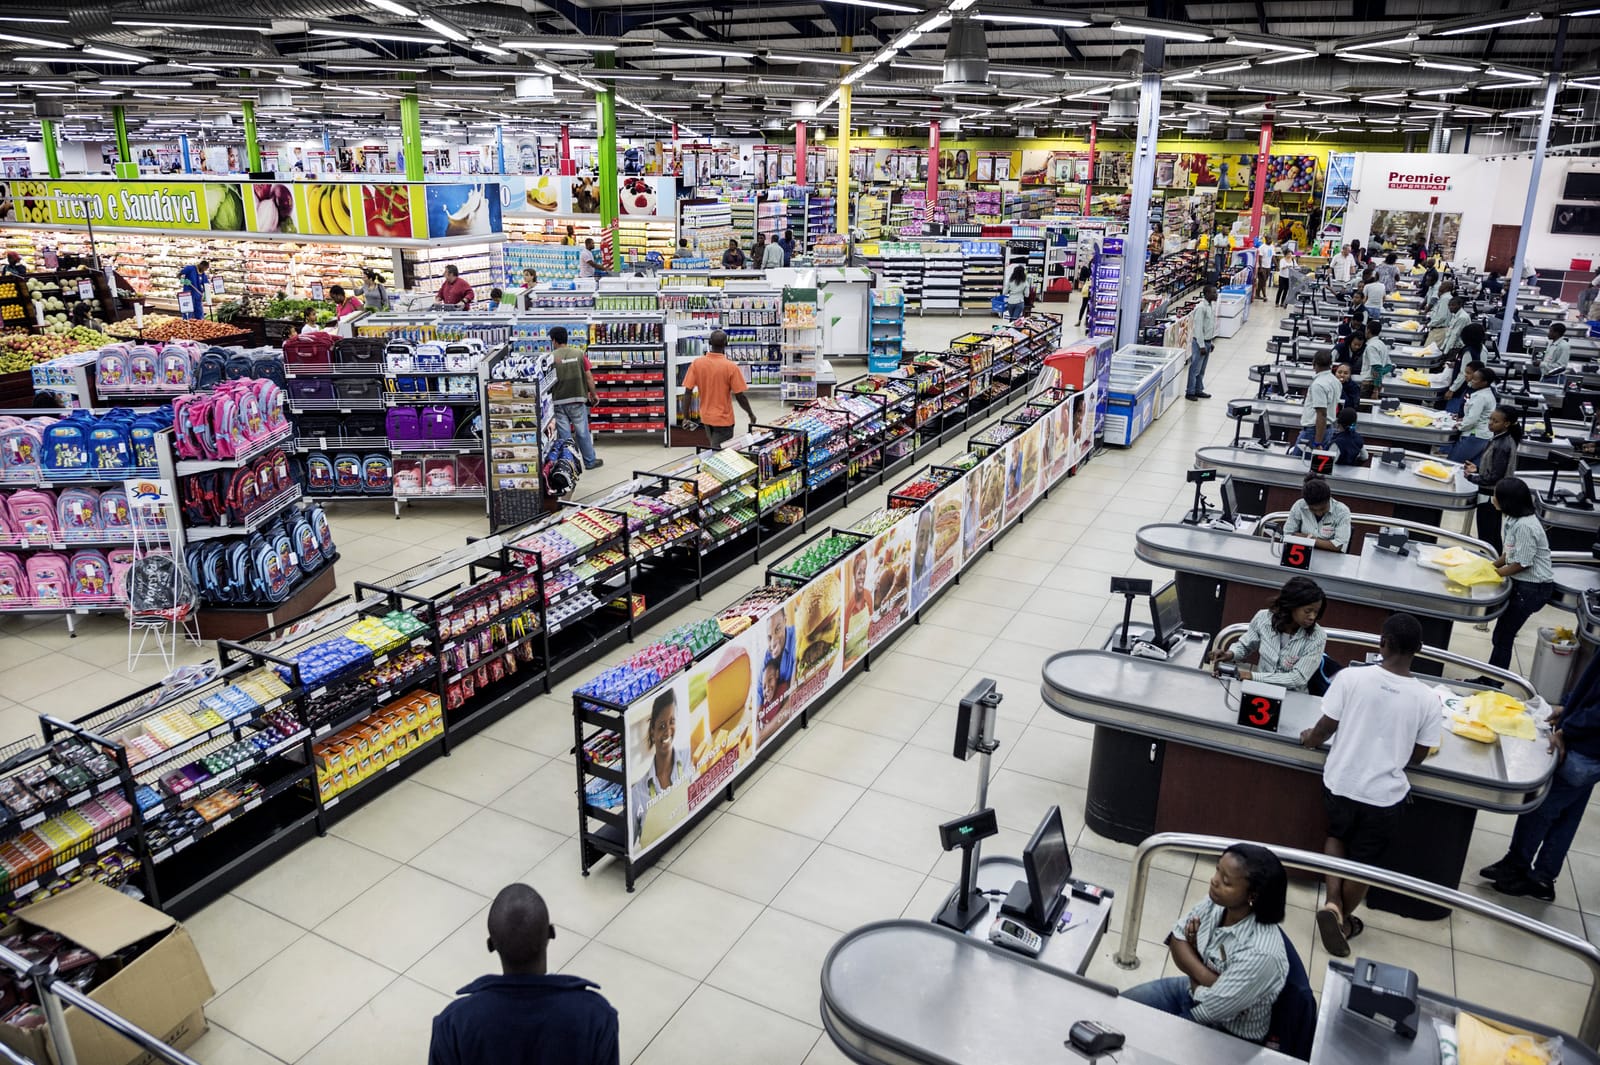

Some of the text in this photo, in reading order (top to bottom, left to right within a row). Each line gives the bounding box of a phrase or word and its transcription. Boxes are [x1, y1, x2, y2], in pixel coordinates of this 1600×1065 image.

[1389, 171, 1450, 183] Premier
[54, 188, 200, 223] Fresco e Saudável
[1317, 455, 1329, 472] 7
[1288, 544, 1305, 565] 5
[1249, 697, 1270, 725] 3
[688, 744, 738, 799] Premier
[637, 804, 644, 817] A
